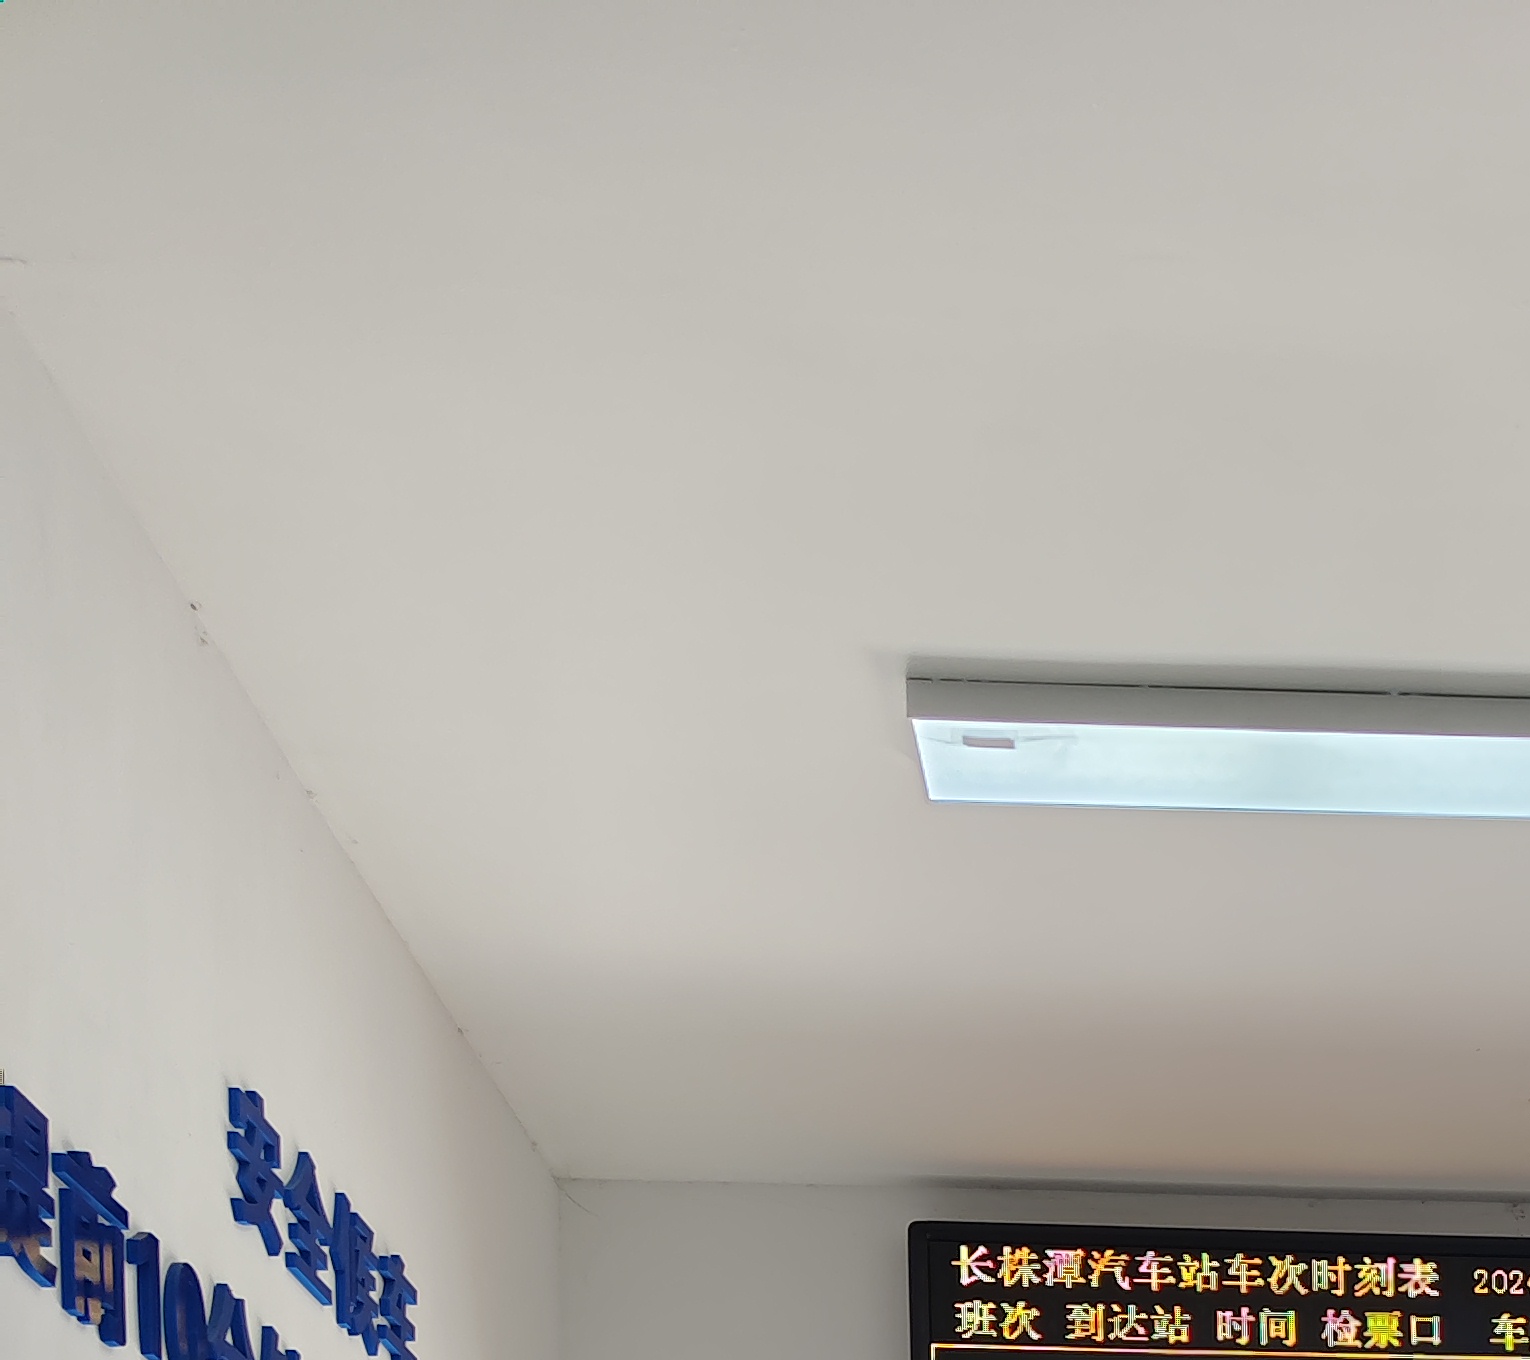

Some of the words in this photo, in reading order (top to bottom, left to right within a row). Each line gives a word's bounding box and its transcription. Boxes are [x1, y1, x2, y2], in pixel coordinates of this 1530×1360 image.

[951, 1245, 1439, 1298] 长株潭汽车站车次时刻表
[954, 1300, 1042, 1340] 班次
[1065, 1303, 1191, 1344] 到达站
[1217, 1307, 1296, 1347] 时间
[1321, 1309, 1441, 1348] 检票口
